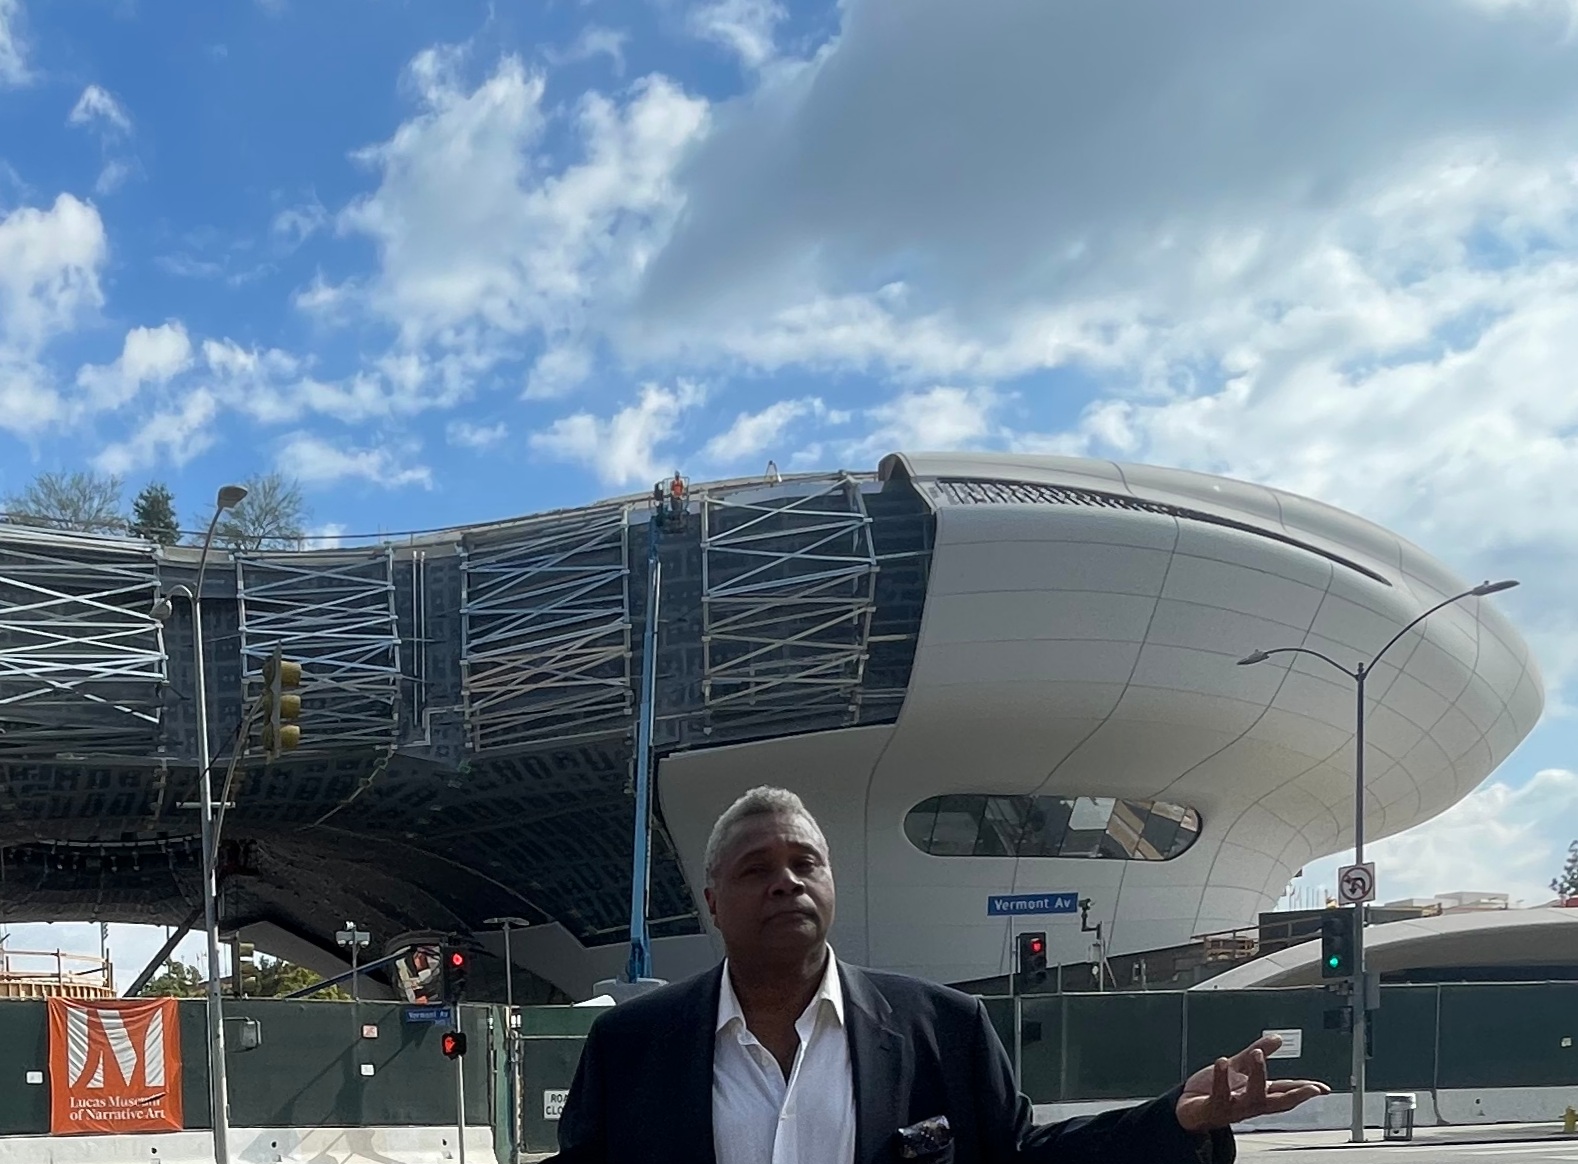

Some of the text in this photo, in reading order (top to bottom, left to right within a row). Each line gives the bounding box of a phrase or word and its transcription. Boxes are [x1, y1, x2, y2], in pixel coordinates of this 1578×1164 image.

[994, 897, 1071, 911] Vermont Av
[70, 1096, 106, 1109] Lucas
[551, 1094, 569, 1103] ROA
[69, 1107, 166, 1121] of Narrative Art
[546, 1106, 563, 1115] CLO
